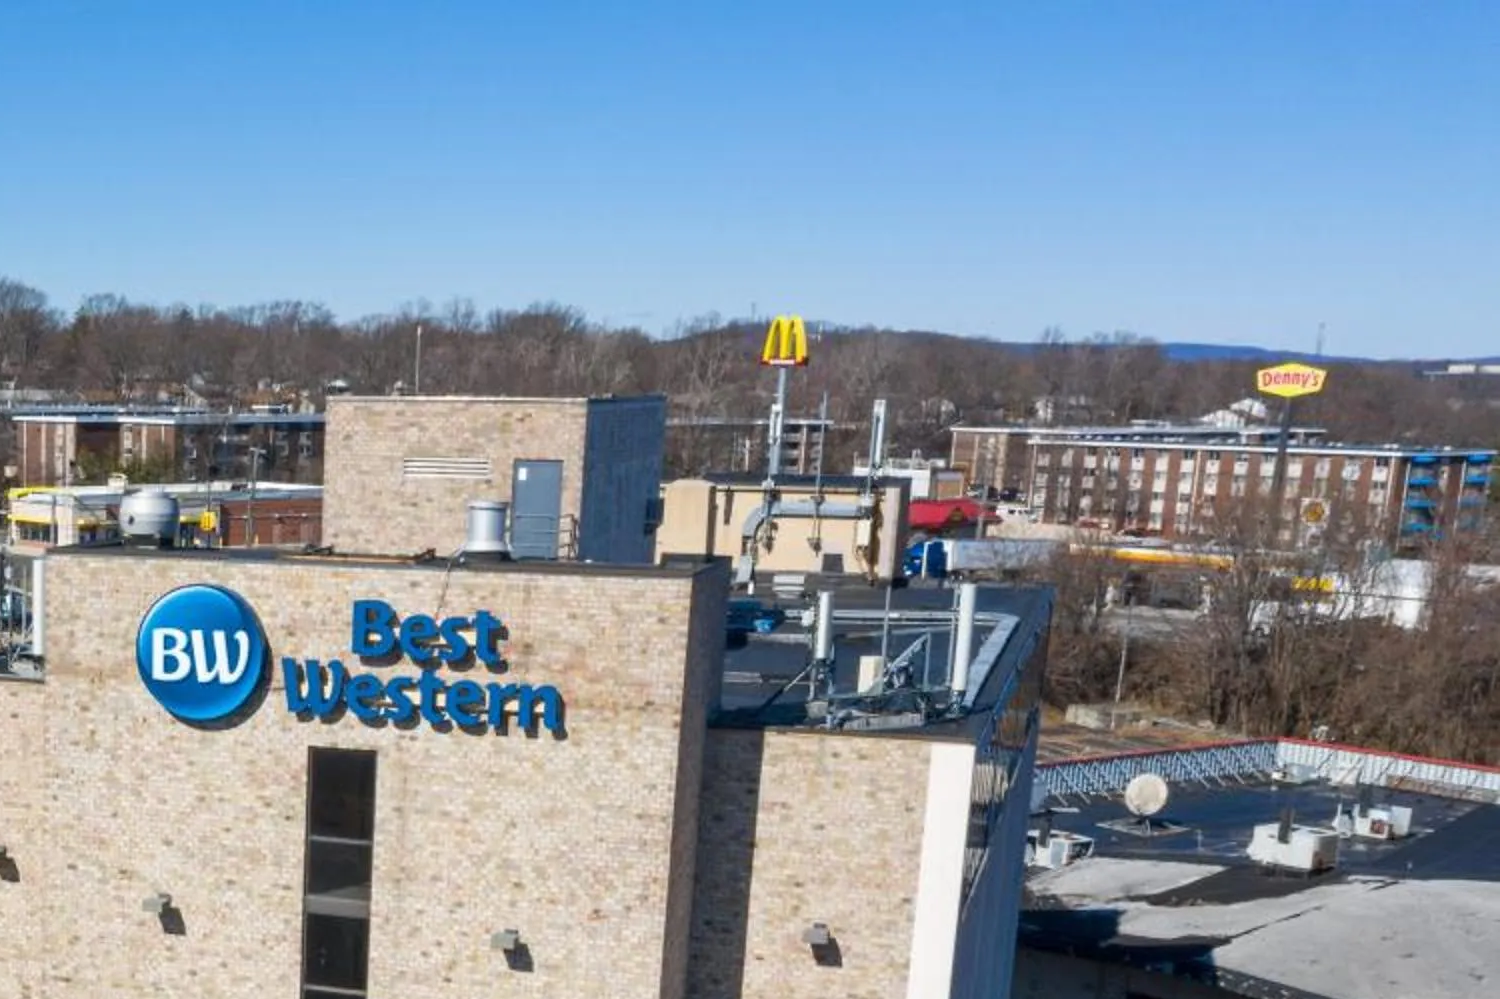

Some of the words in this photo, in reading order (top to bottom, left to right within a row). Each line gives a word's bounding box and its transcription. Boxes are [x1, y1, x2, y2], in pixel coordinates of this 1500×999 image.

[1261, 369, 1320, 388] Denny's
[150, 626, 250, 685] BW
[350, 599, 504, 666] Best
[280, 656, 566, 734] Western
